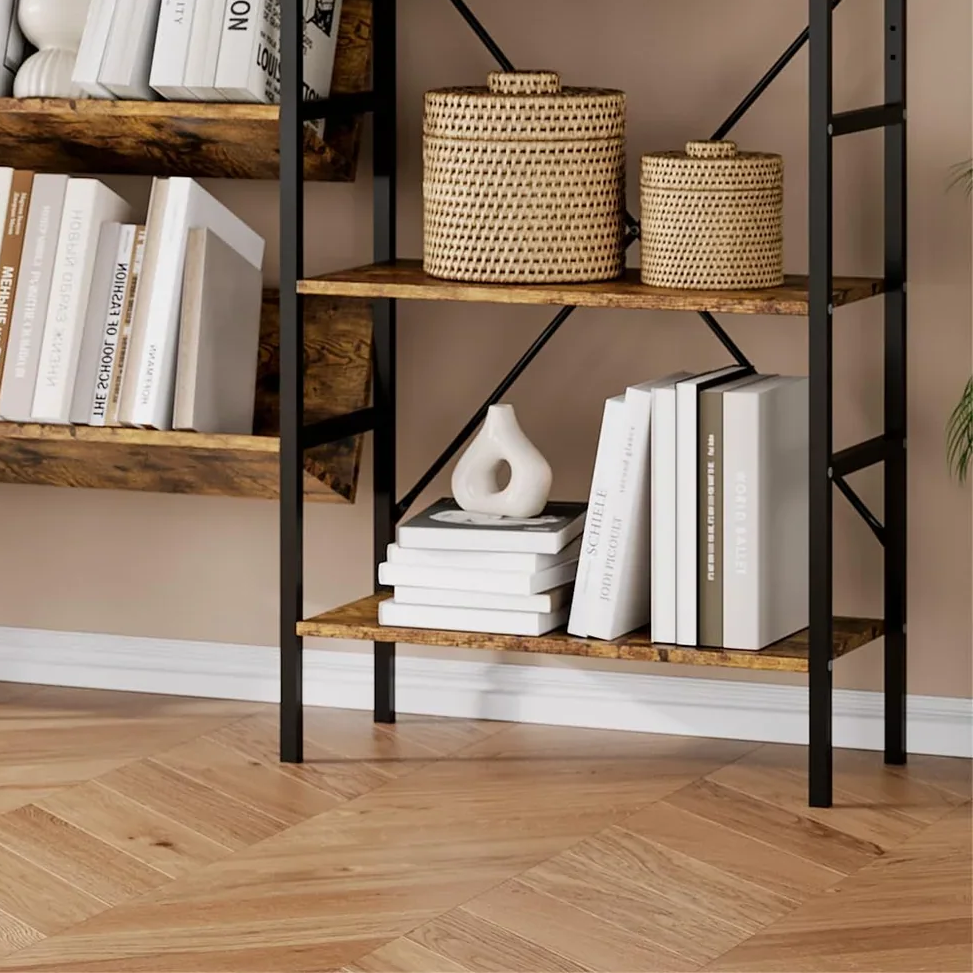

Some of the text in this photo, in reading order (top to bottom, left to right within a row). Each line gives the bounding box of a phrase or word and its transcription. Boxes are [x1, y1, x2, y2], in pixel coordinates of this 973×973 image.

[54, 270, 74, 324] ОБРАЗ
[43, 326, 66, 389] ЖИЗНИ
[584, 488, 608, 557] SCHIELE
[598, 515, 623, 602] JODI PICOULT
